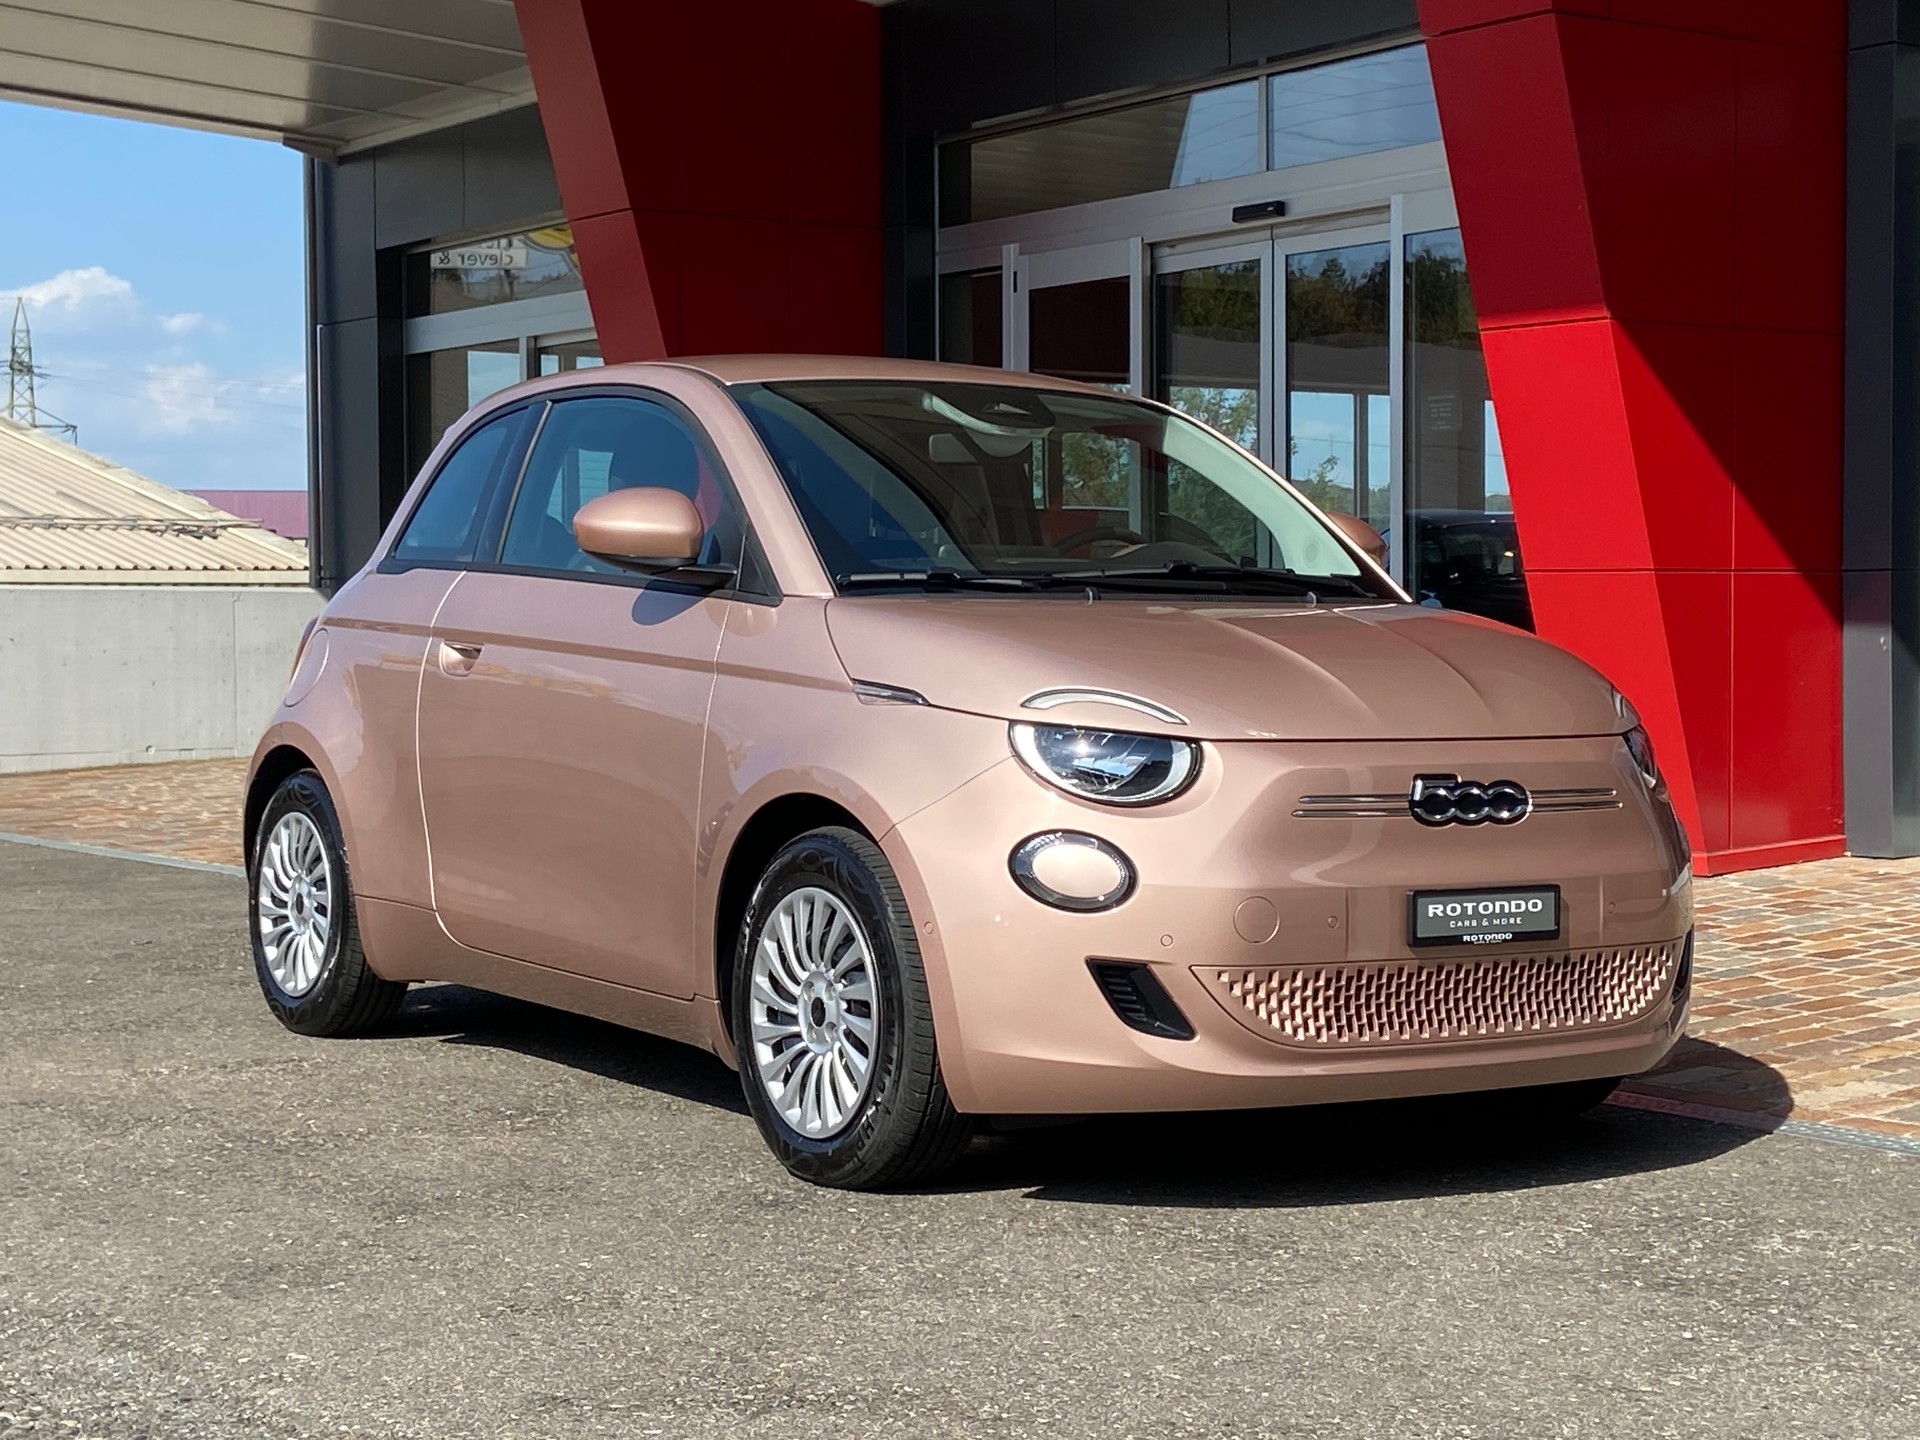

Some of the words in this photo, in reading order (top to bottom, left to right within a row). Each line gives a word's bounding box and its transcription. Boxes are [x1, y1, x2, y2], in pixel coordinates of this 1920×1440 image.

[1410, 774, 1532, 827] 500
[1428, 899, 1542, 917] ROTONDO
[1481, 918, 1489, 926] &
[1493, 917, 1522, 925] MORE
[1462, 933, 1513, 942] ROTONDO
